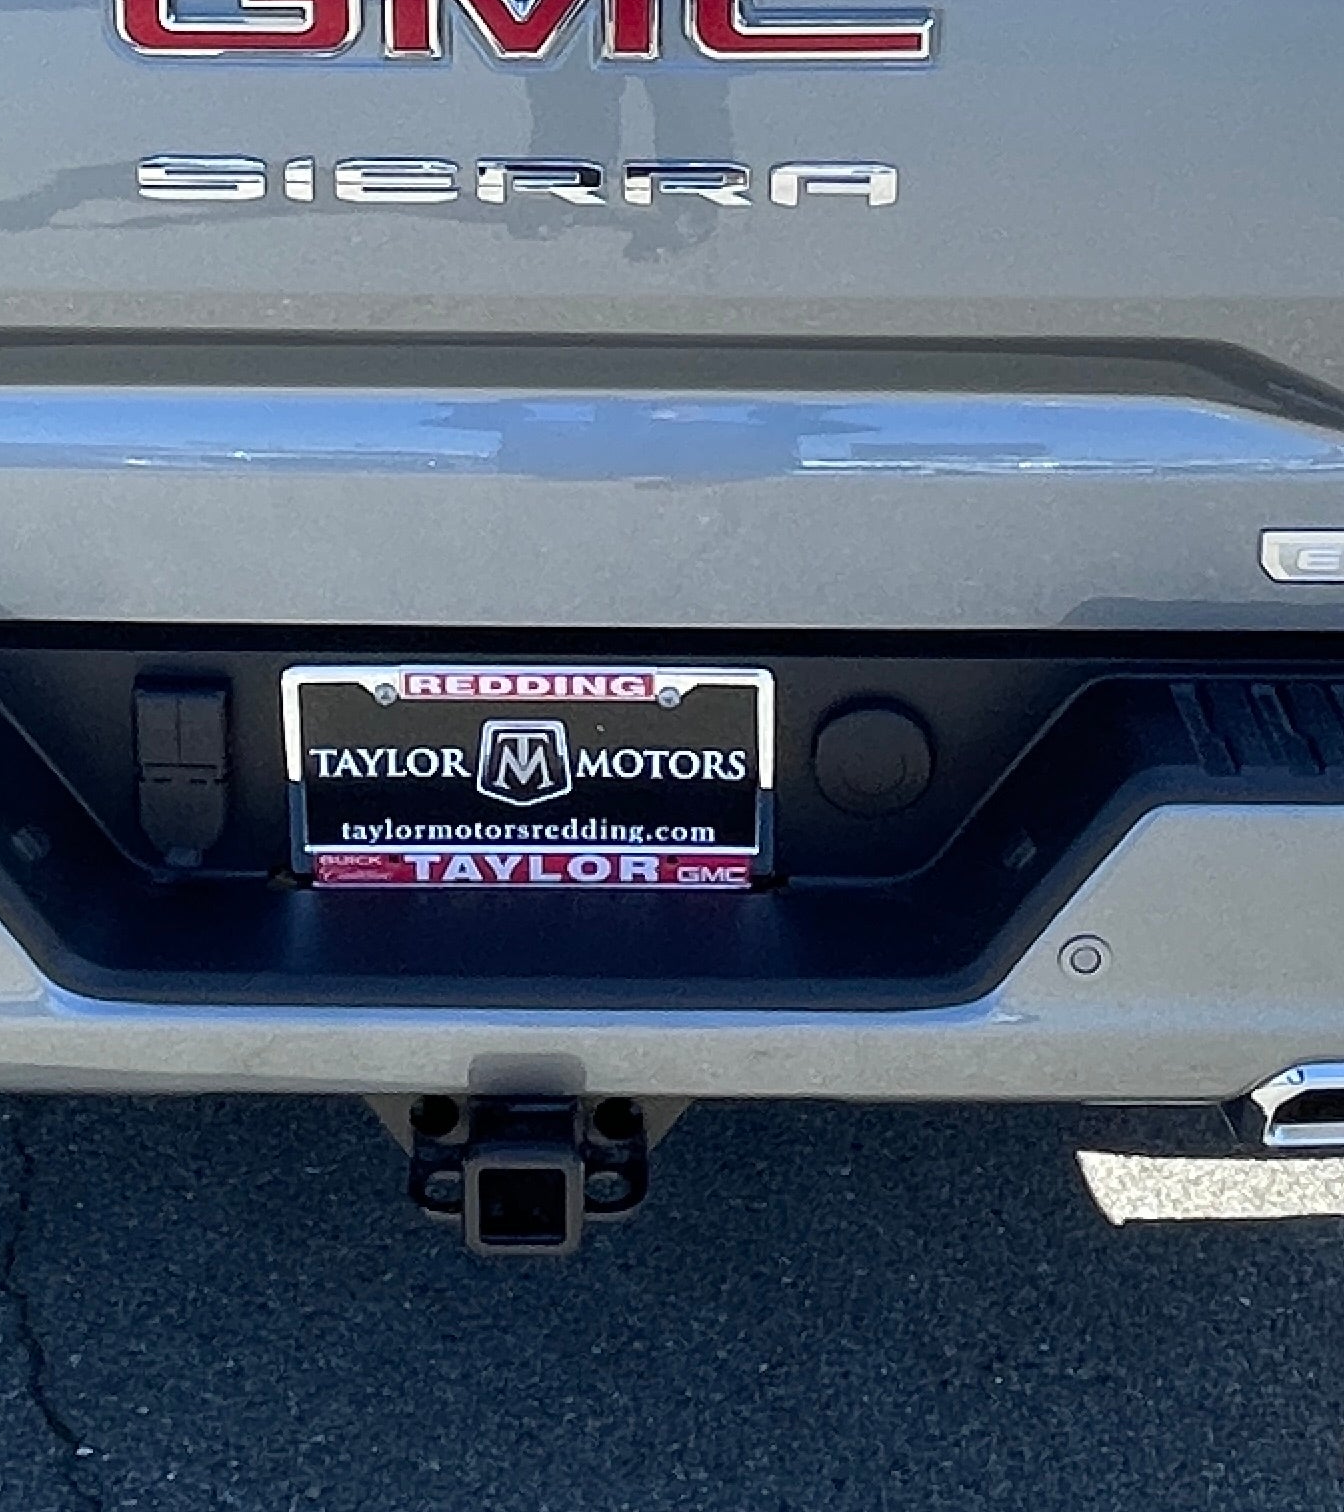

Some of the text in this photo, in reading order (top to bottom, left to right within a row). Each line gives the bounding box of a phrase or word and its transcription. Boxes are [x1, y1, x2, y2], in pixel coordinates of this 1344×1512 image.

[136, 153, 899, 207] SIERRA
[407, 672, 646, 697] REDDING
[309, 746, 471, 780] TAYLOR
[575, 747, 748, 781] MOTORS
[341, 817, 716, 845] taylormotorsredding.com
[402, 854, 661, 882] TAYLOR
[676, 866, 748, 883] GMC
